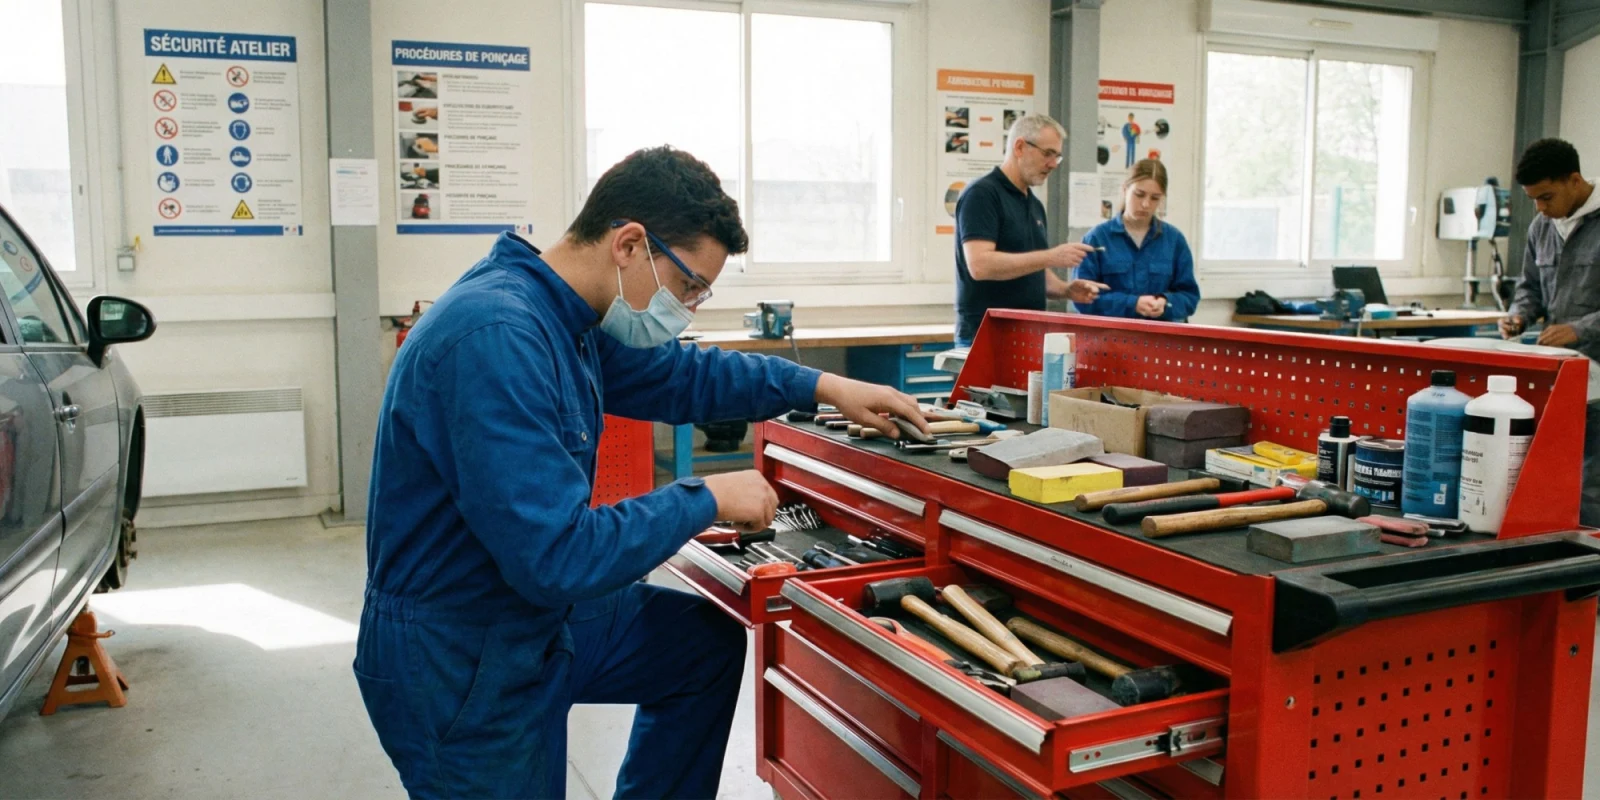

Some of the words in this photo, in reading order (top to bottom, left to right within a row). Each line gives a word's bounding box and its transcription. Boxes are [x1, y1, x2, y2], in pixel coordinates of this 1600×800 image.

[150, 33, 227, 54] SÉCURITÉ
[230, 40, 290, 57] ATELIER
[395, 46, 463, 61] PROCÉDURES
[465, 51, 479, 62] DE
[481, 52, 527, 66] PONÇAGE
